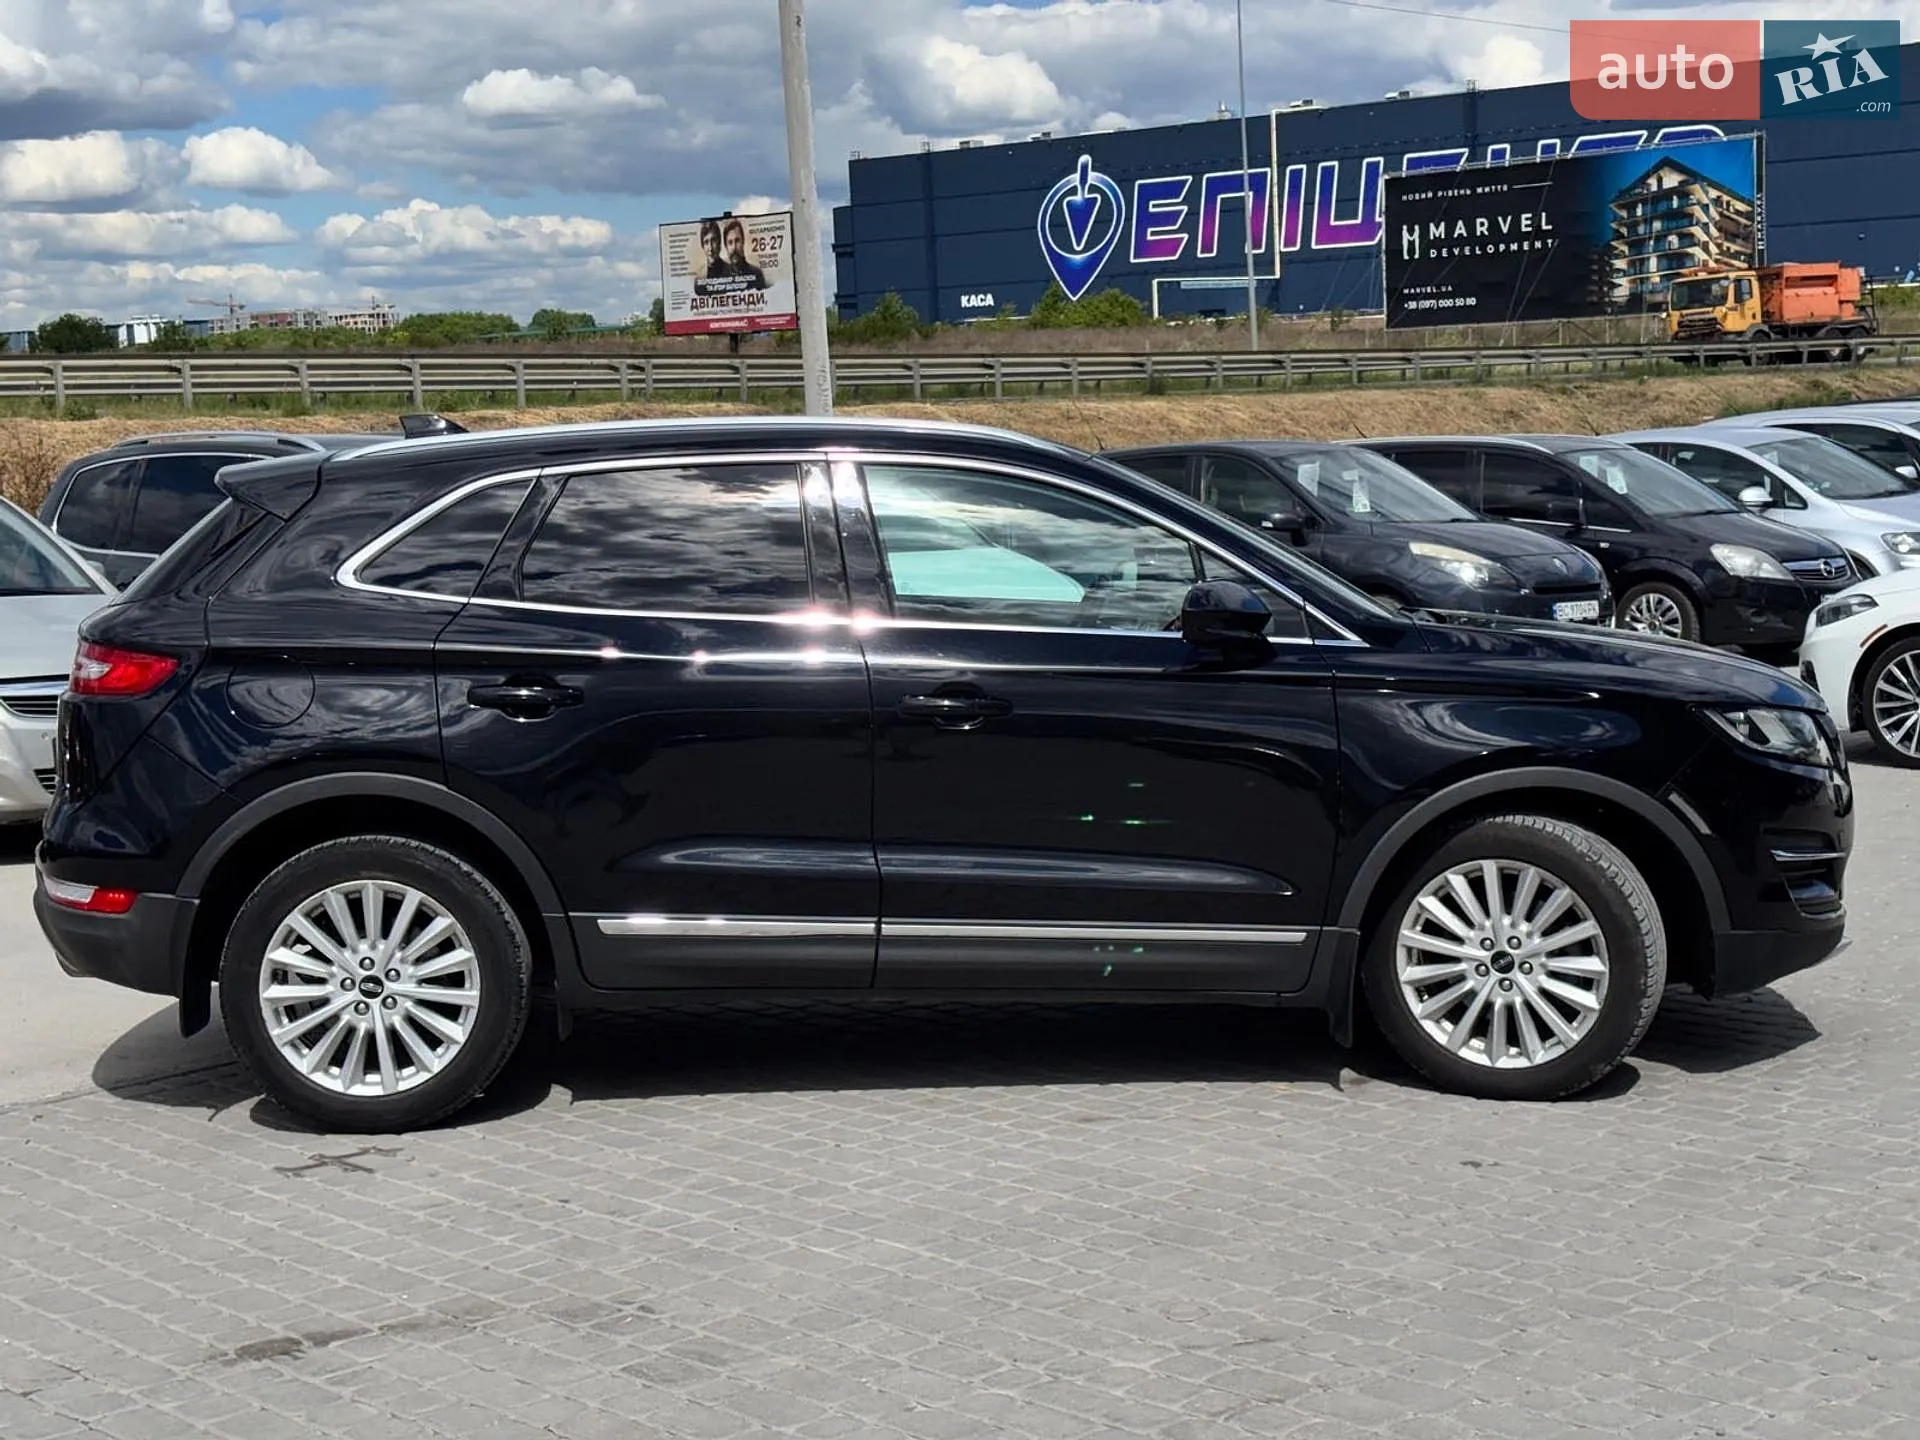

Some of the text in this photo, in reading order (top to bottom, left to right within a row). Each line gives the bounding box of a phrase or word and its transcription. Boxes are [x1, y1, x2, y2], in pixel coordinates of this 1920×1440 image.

[1437, 187, 1471, 198] РІВЕНЬ
[1429, 212, 1553, 240] MARVEL
[1430, 238, 1555, 258] DEVELOPMENT
[961, 293, 995, 308] КАСА
